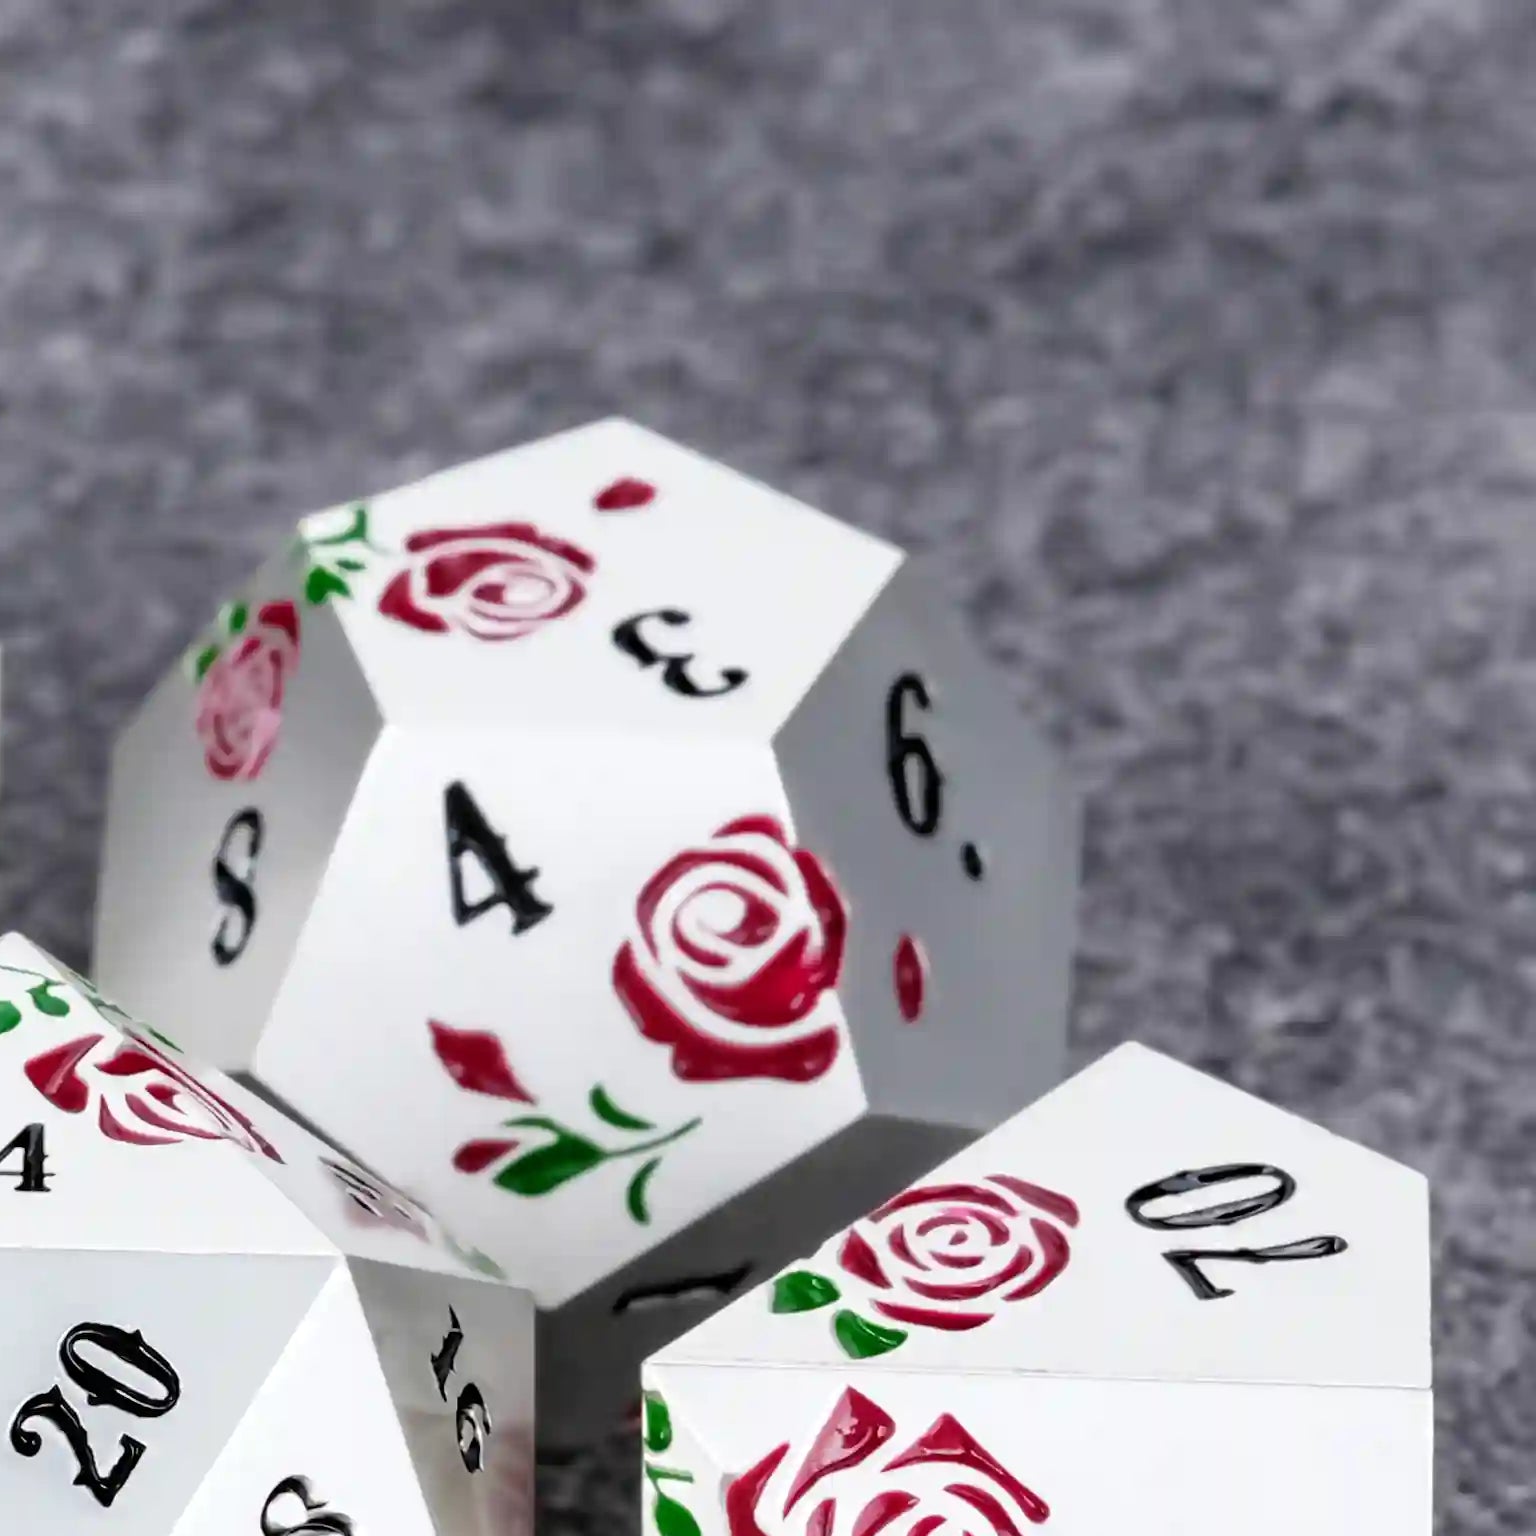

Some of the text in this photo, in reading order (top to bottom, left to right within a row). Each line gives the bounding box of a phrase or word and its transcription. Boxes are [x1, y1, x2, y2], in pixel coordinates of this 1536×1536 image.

[613, 610, 747, 697] 3
[214, 809, 261, 964] 8
[445, 782, 553, 935] 4
[10, 1322, 180, 1507] 20
